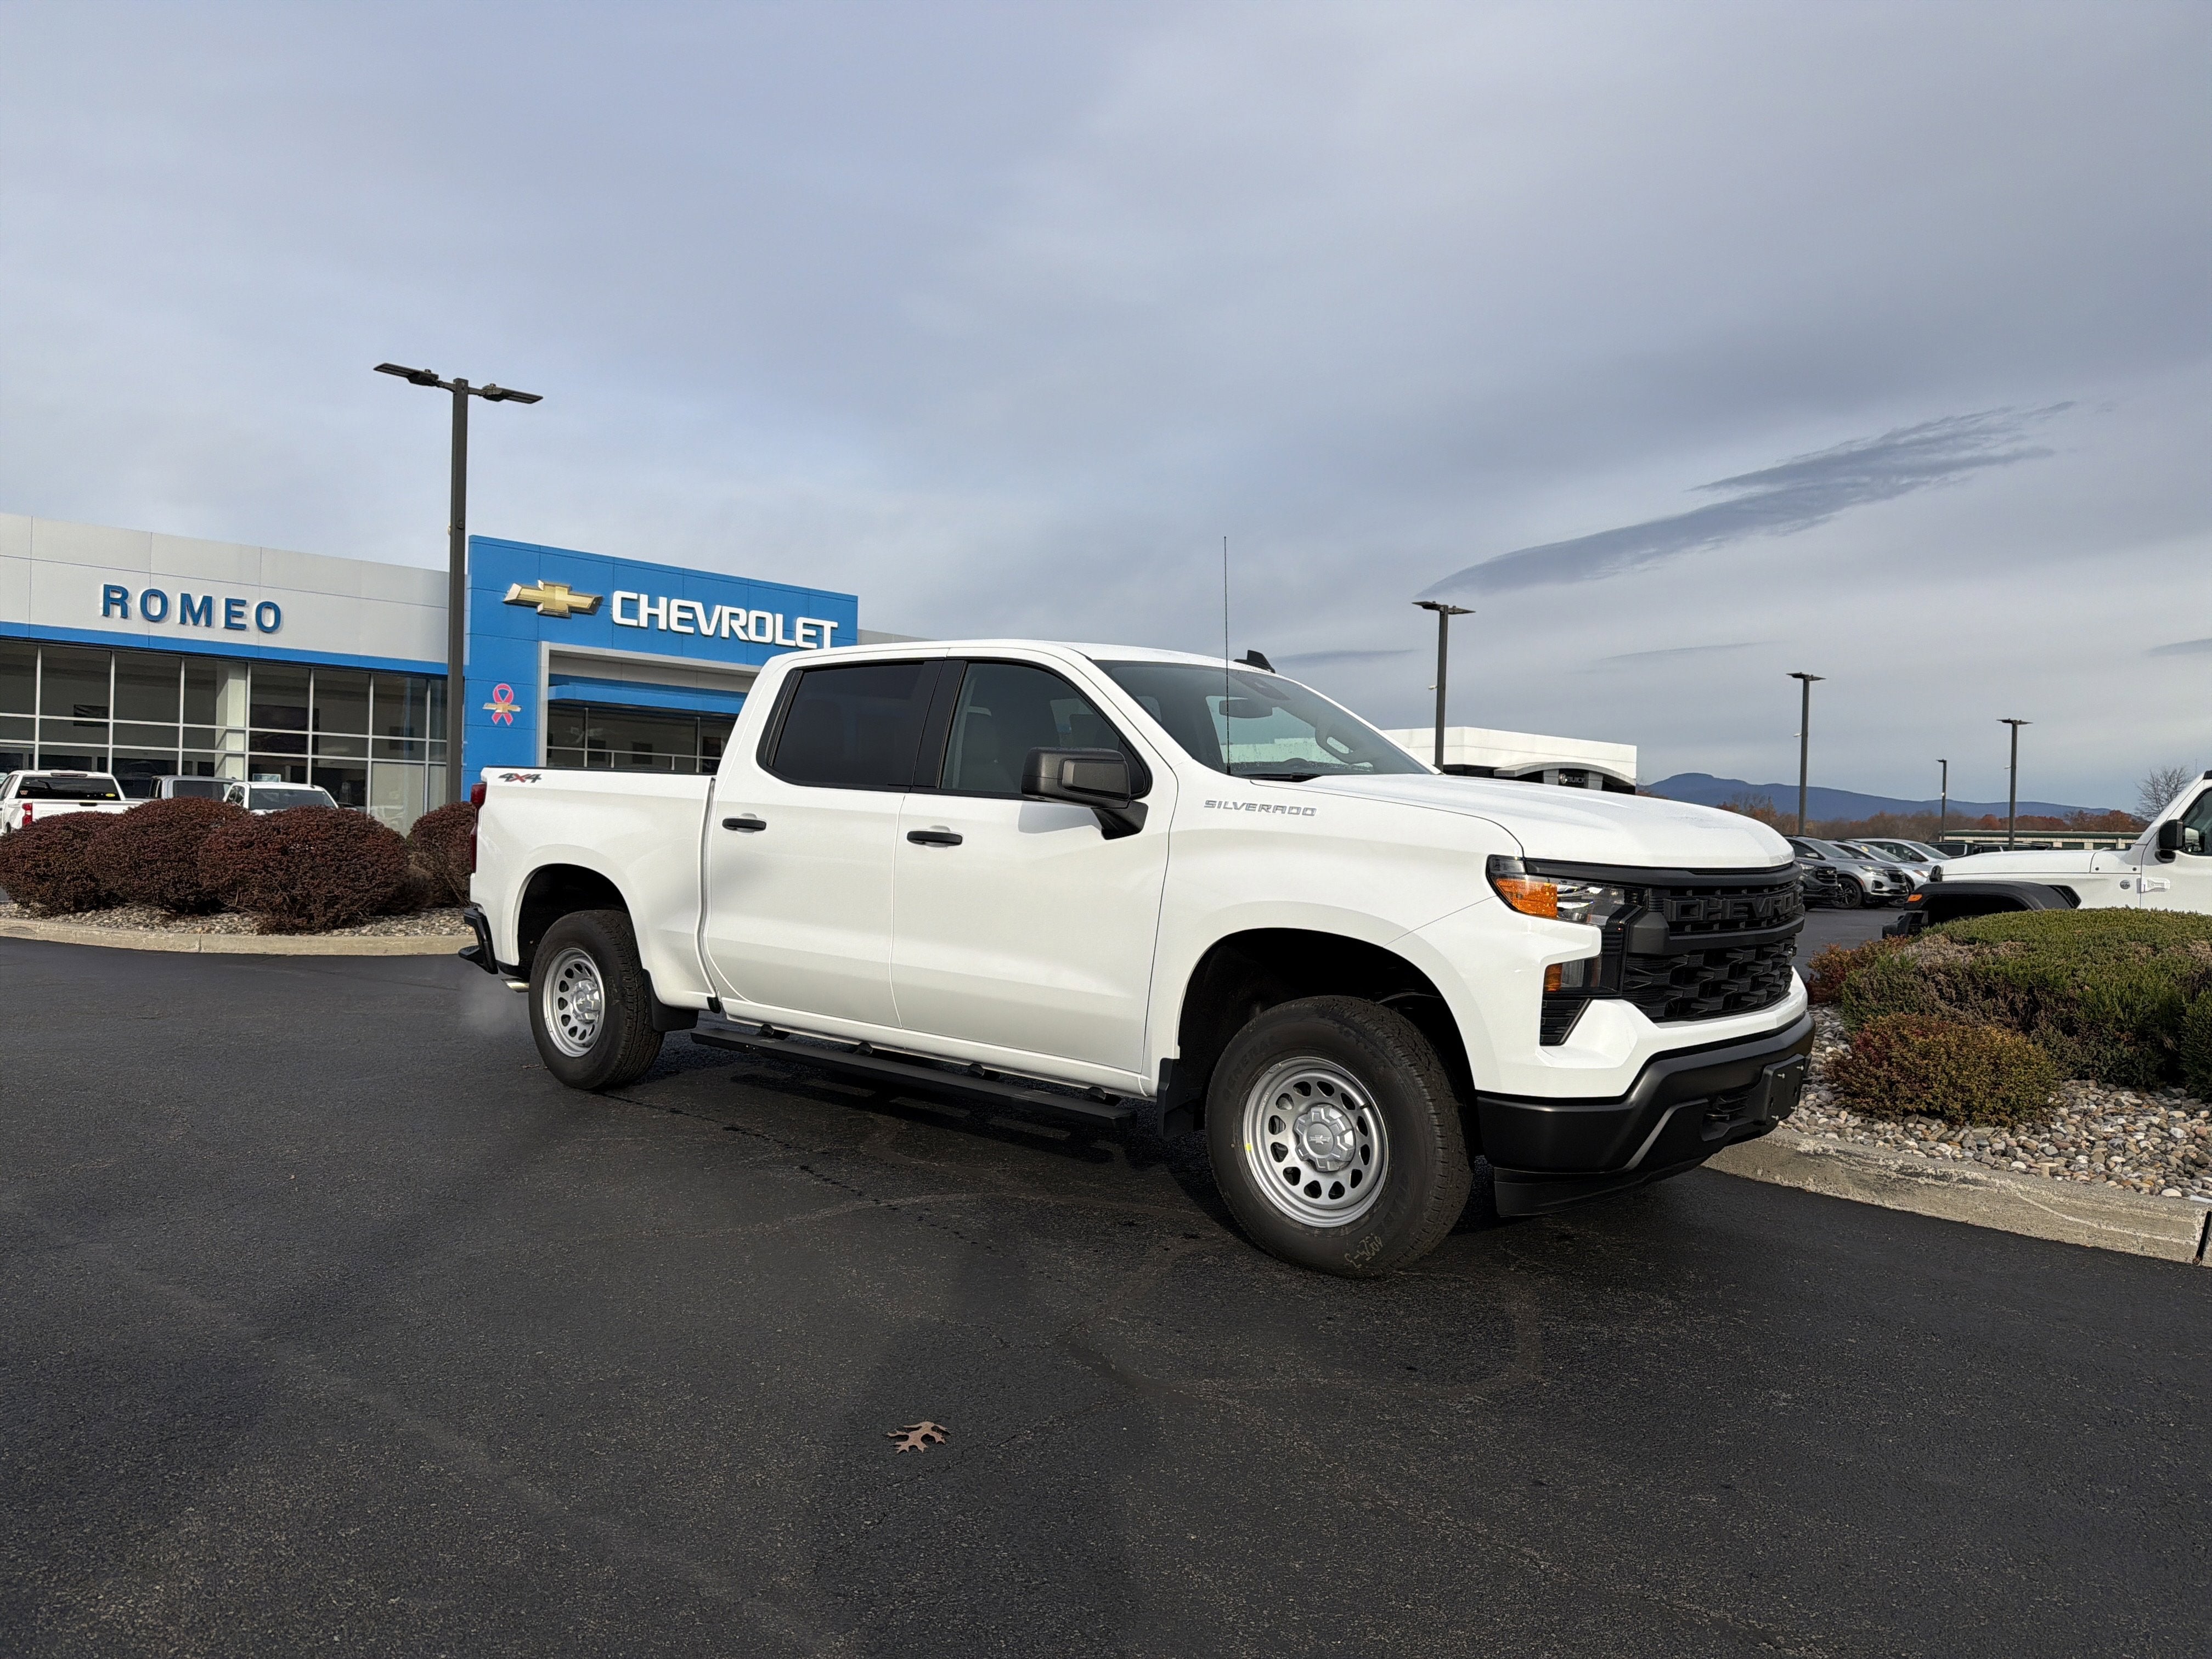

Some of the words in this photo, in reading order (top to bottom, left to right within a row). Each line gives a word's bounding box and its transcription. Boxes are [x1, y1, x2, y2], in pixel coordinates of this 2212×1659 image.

[102, 584, 281, 633] ROMEO
[612, 590, 838, 649] CHEVROLET
[1204, 800, 1317, 816] SILVERADO
